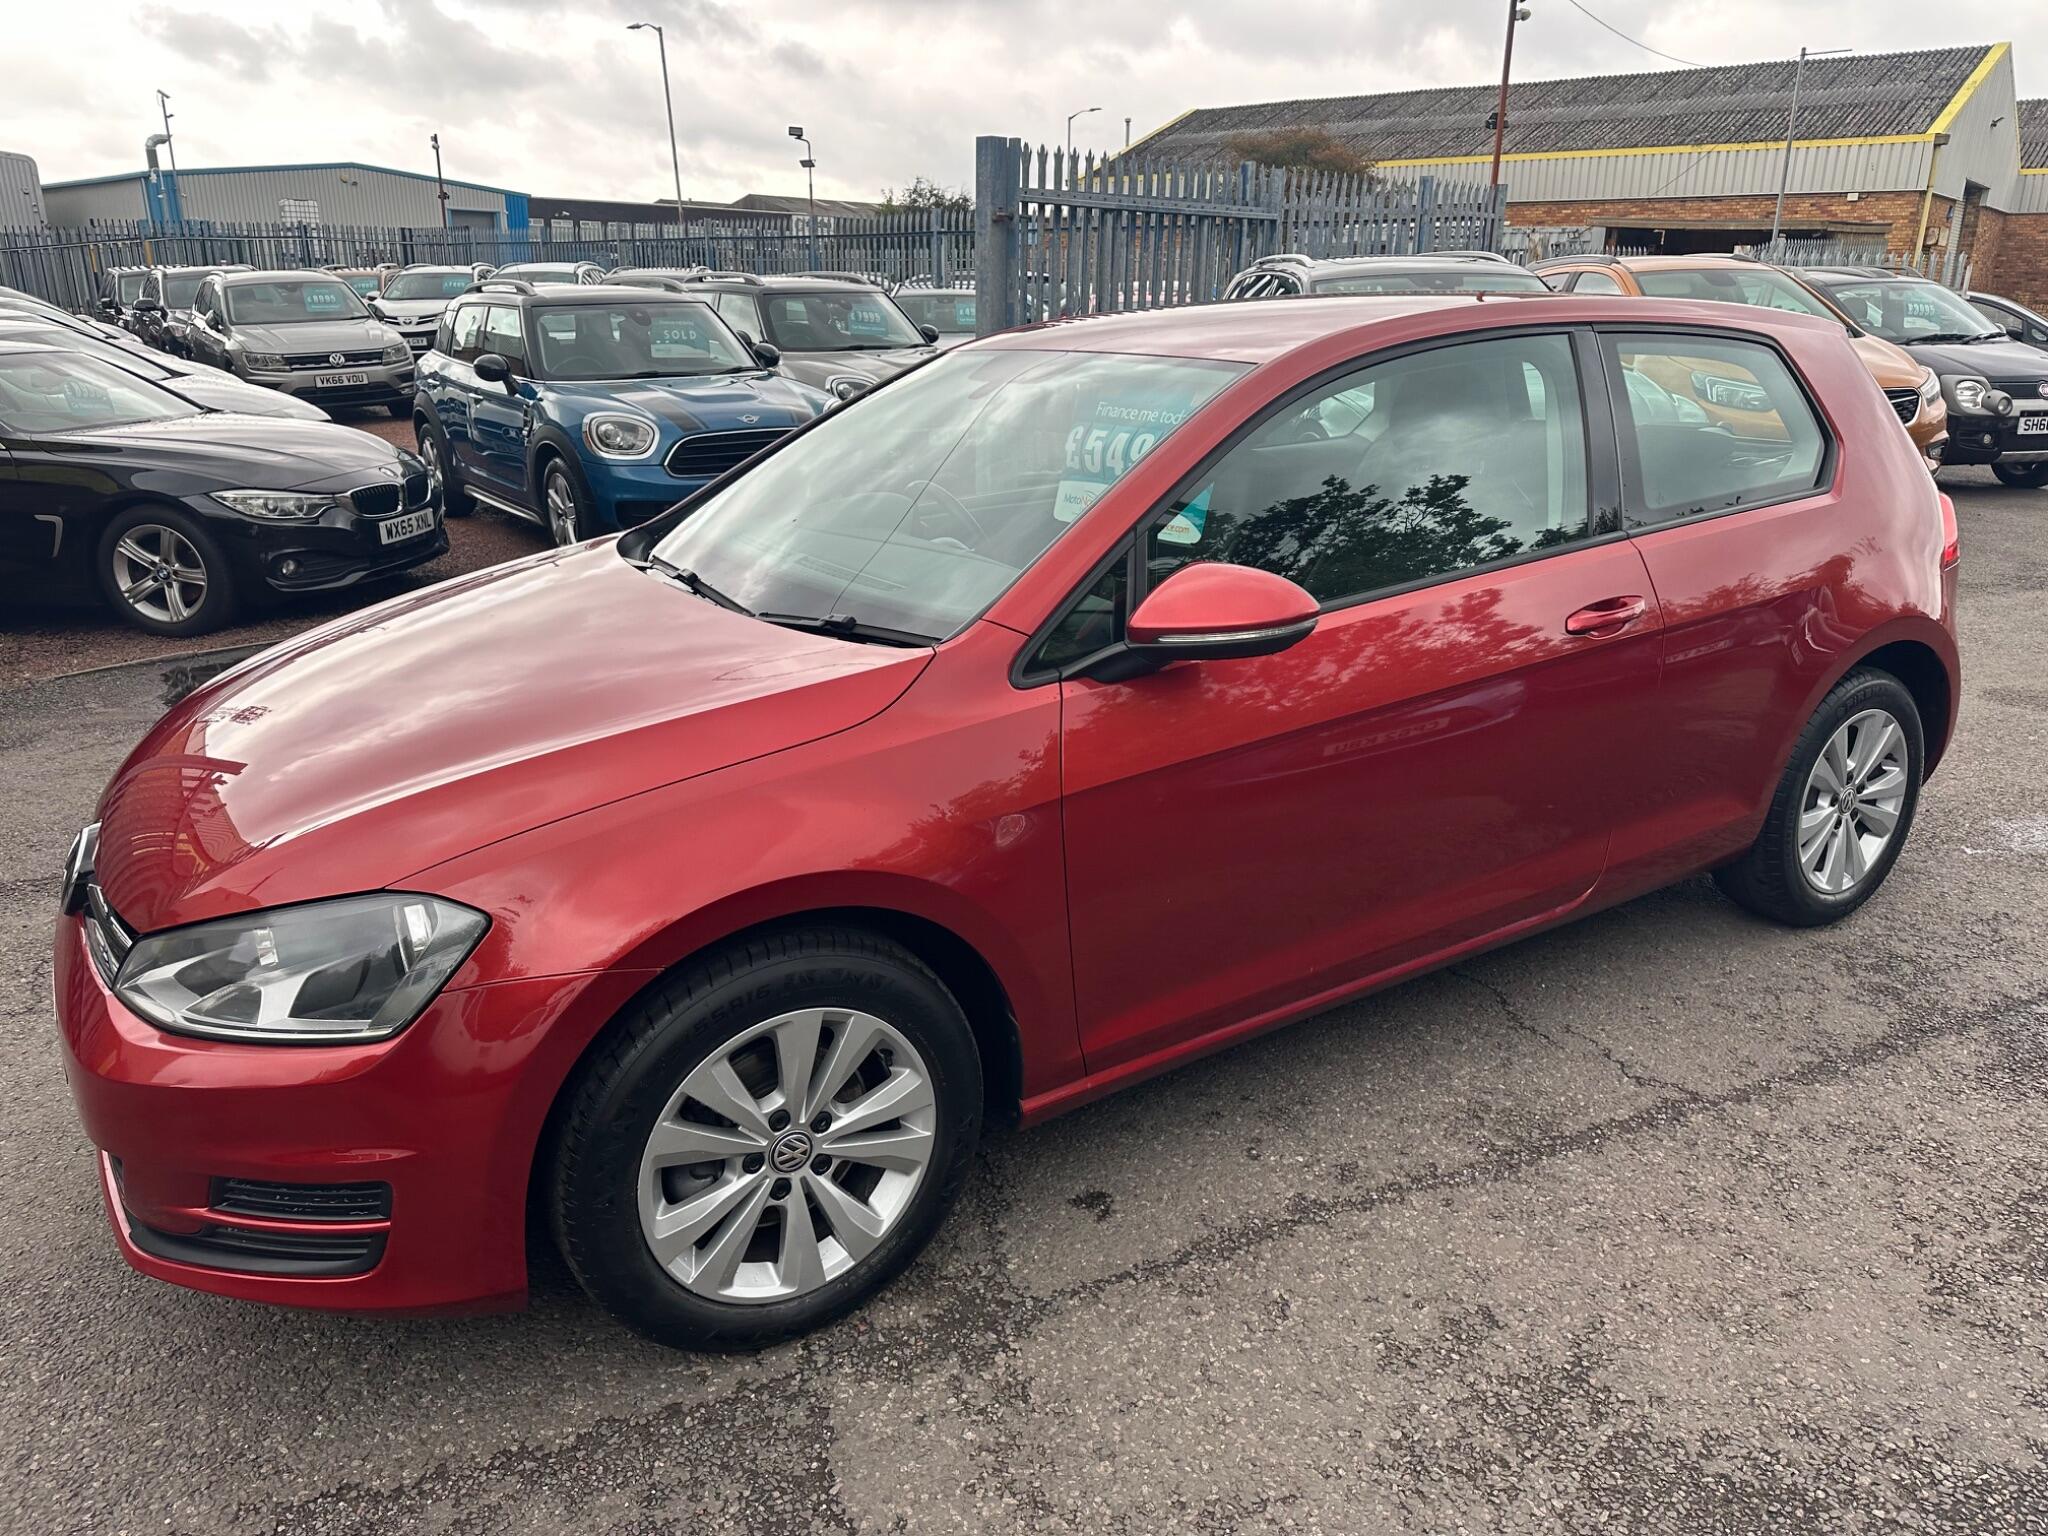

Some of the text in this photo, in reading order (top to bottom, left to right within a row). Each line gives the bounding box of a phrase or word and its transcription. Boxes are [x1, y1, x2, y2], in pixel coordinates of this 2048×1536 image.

[664, 330, 697, 339] SOLD
[319, 376, 344, 385] VK66
[1095, 402, 1188, 425] Finance me tod
[2023, 418, 2048, 431] SH6
[1065, 425, 1156, 476] £549
[385, 512, 432, 540] WX65 XNL
